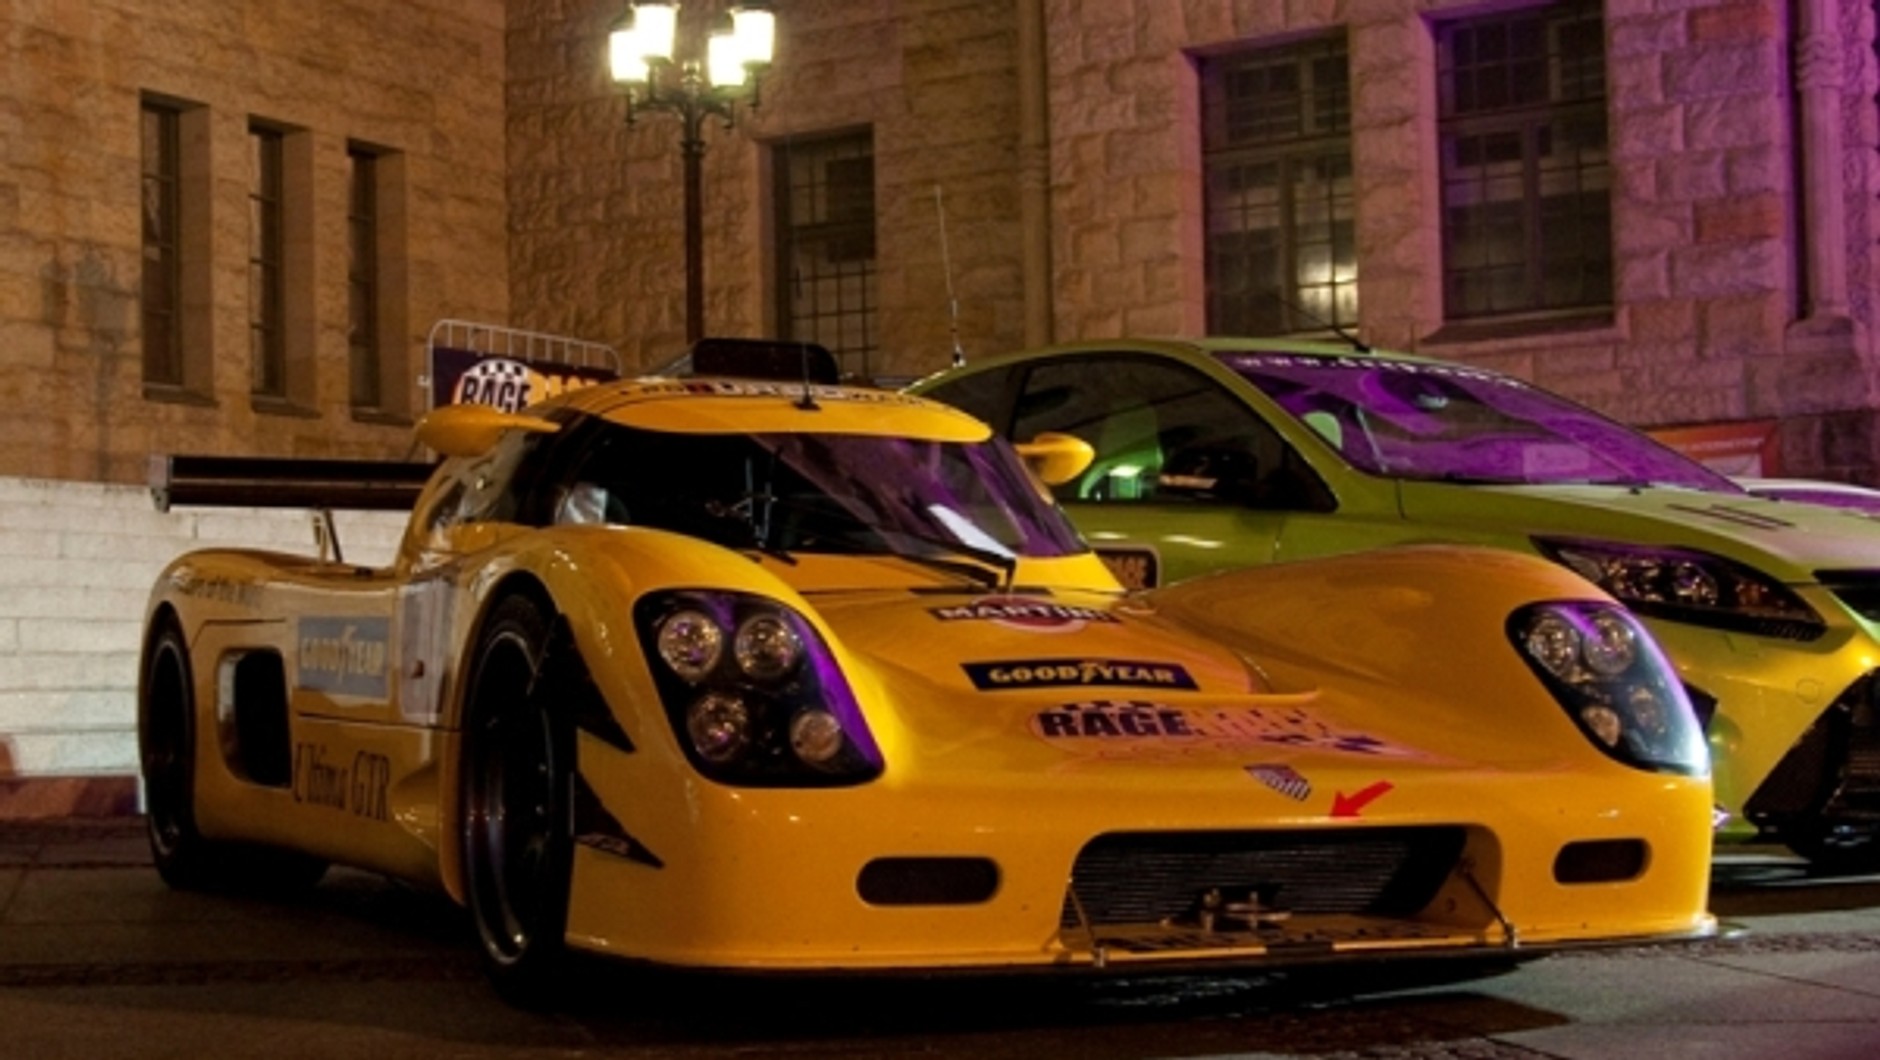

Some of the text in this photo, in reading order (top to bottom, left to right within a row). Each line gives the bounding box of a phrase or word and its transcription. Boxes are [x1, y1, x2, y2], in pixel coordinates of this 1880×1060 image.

[461, 375, 531, 414] RAGE
[937, 603, 1107, 620] MARTINI
[988, 663, 1176, 683] GOODYEAR
[1038, 709, 1193, 737] RAGE
[353, 750, 390, 823] GTR
